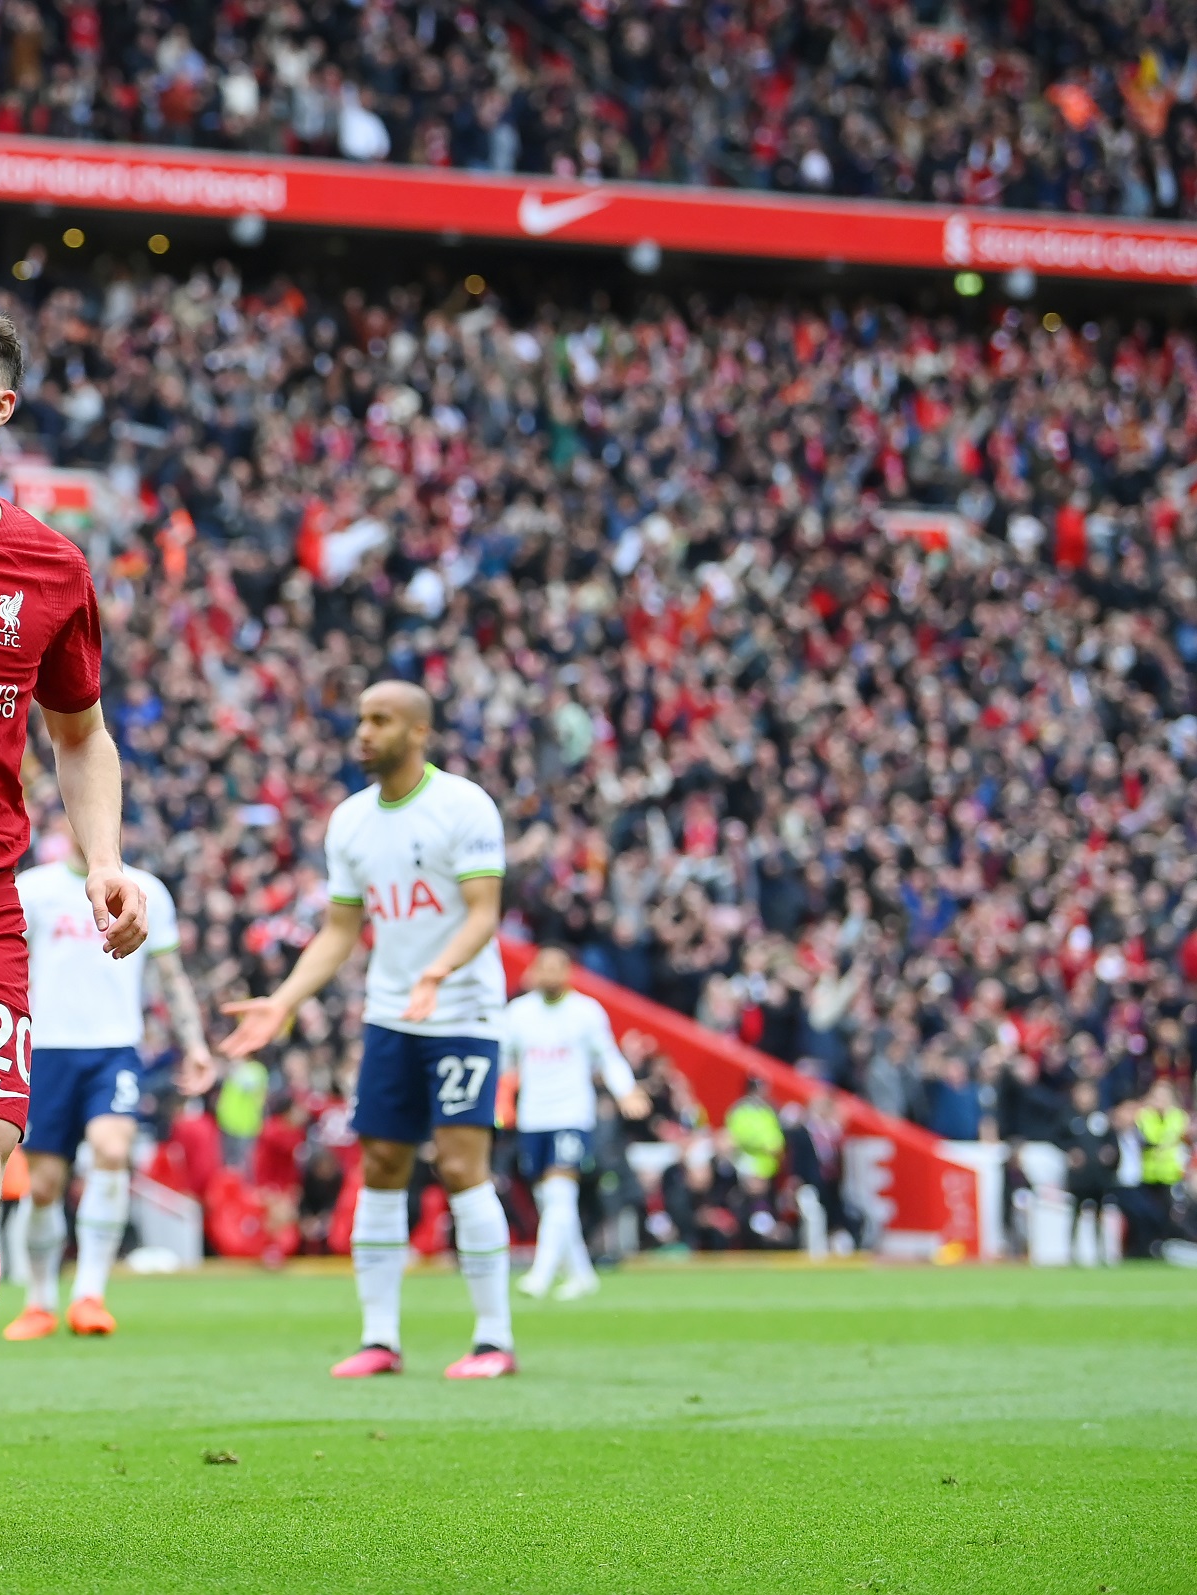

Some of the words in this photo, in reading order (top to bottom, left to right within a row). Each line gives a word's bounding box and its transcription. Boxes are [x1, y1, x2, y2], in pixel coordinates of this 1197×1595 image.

[131, 165, 286, 211] chartered
[974, 226, 1104, 269] standard
[366, 879, 445, 921] AIA
[436, 1055, 491, 1102] 27
